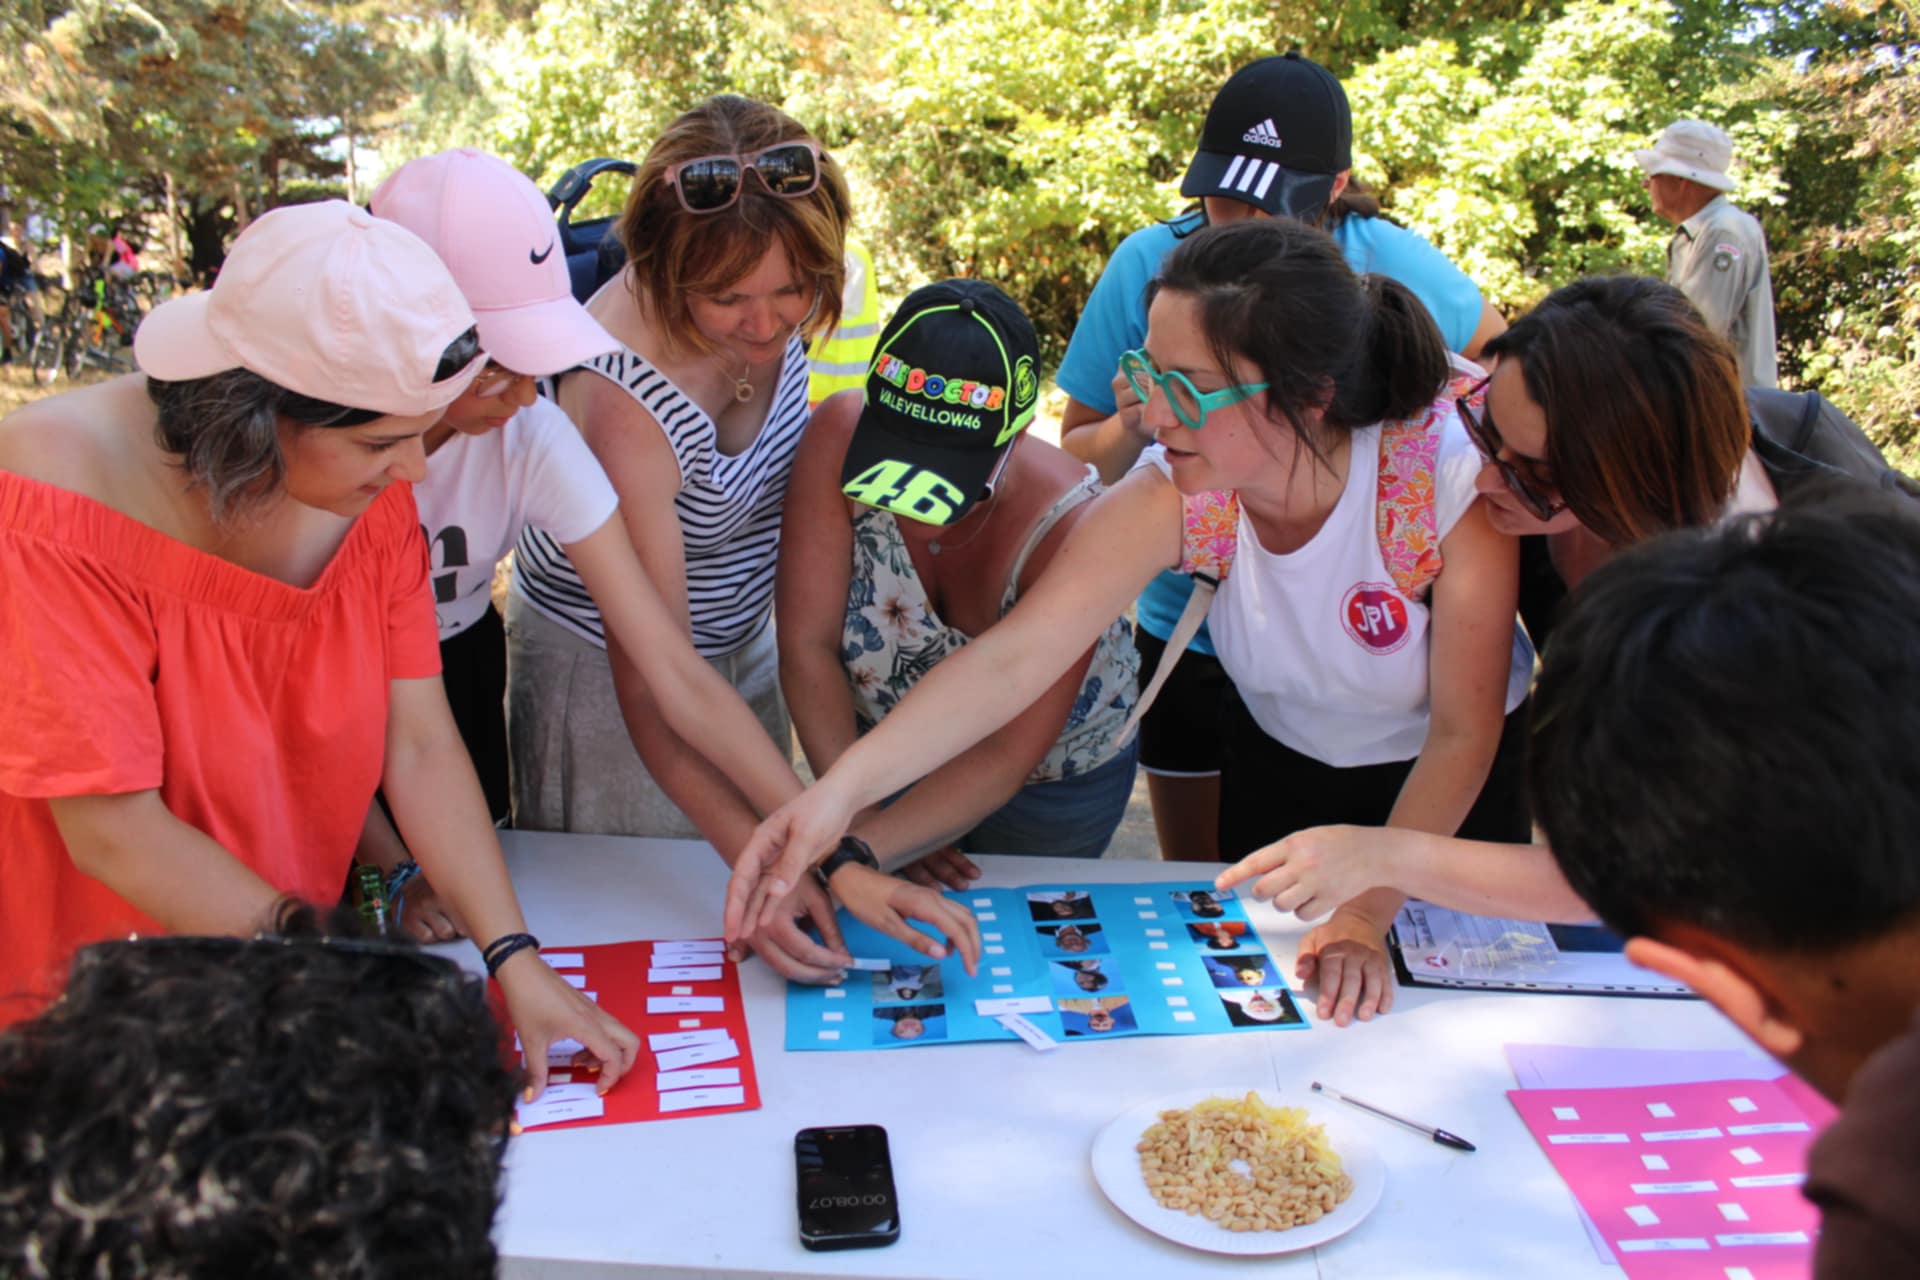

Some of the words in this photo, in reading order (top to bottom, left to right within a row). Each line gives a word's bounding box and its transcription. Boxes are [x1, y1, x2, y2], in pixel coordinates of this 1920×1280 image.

[1243, 133, 1282, 148] adidas
[875, 353, 910, 388] THE
[905, 367, 1005, 410] DOCTOR
[879, 387, 981, 430] VALEYELLOW46
[842, 459, 965, 526] 46
